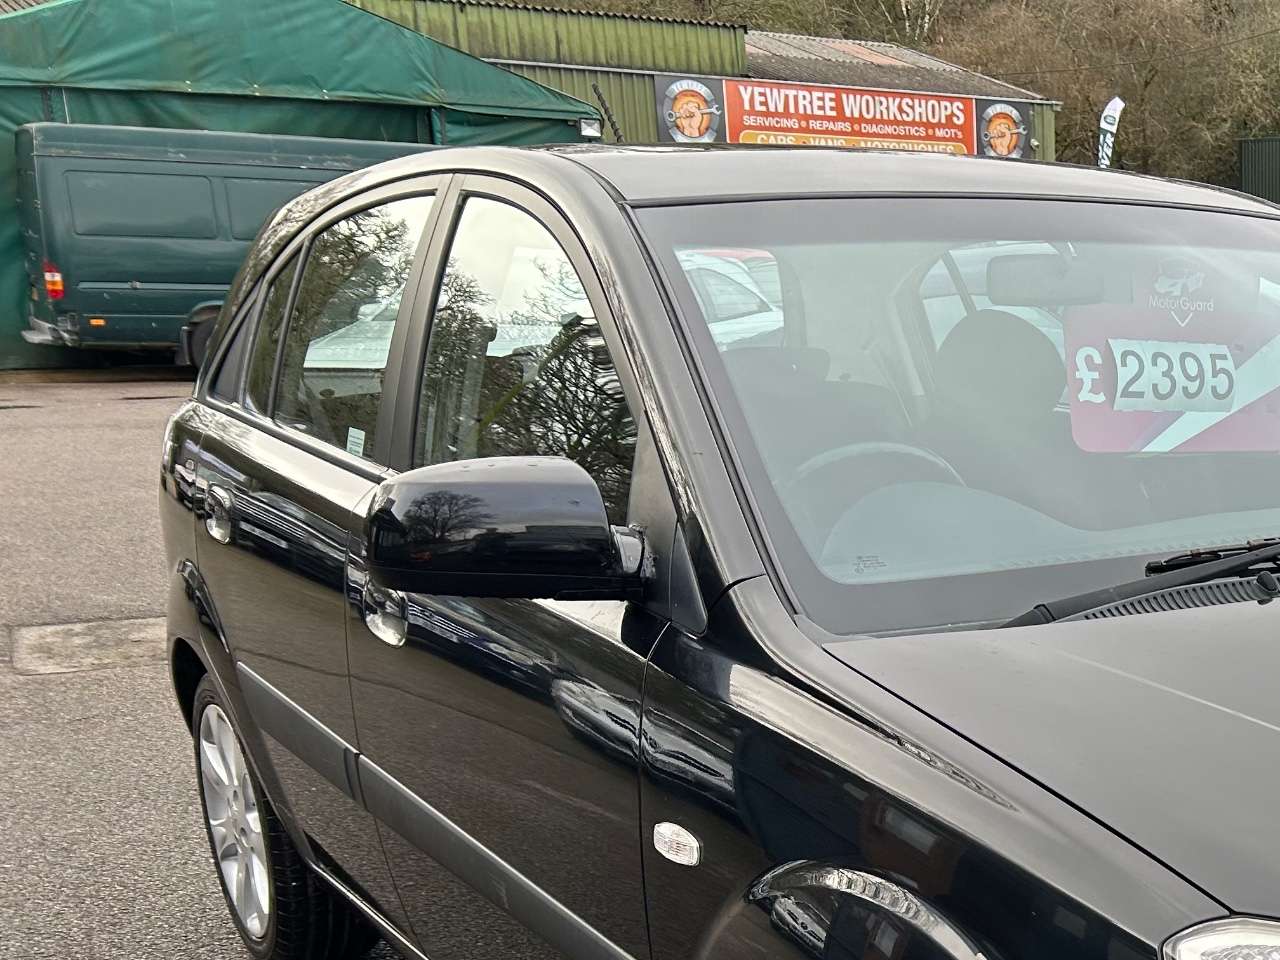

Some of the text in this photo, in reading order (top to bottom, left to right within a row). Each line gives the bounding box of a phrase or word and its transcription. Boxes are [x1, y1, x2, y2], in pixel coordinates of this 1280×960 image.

[738, 85, 837, 116] YEWTREE
[841, 93, 965, 125] WORKSHOPS
[743, 115, 799, 129] SERVICING
[808, 120, 852, 132] REPAIRS
[861, 123, 926, 136] DIAGNOSTICS
[1149, 296, 1214, 312] MotorGuard
[1119, 349, 1234, 401] 2395
